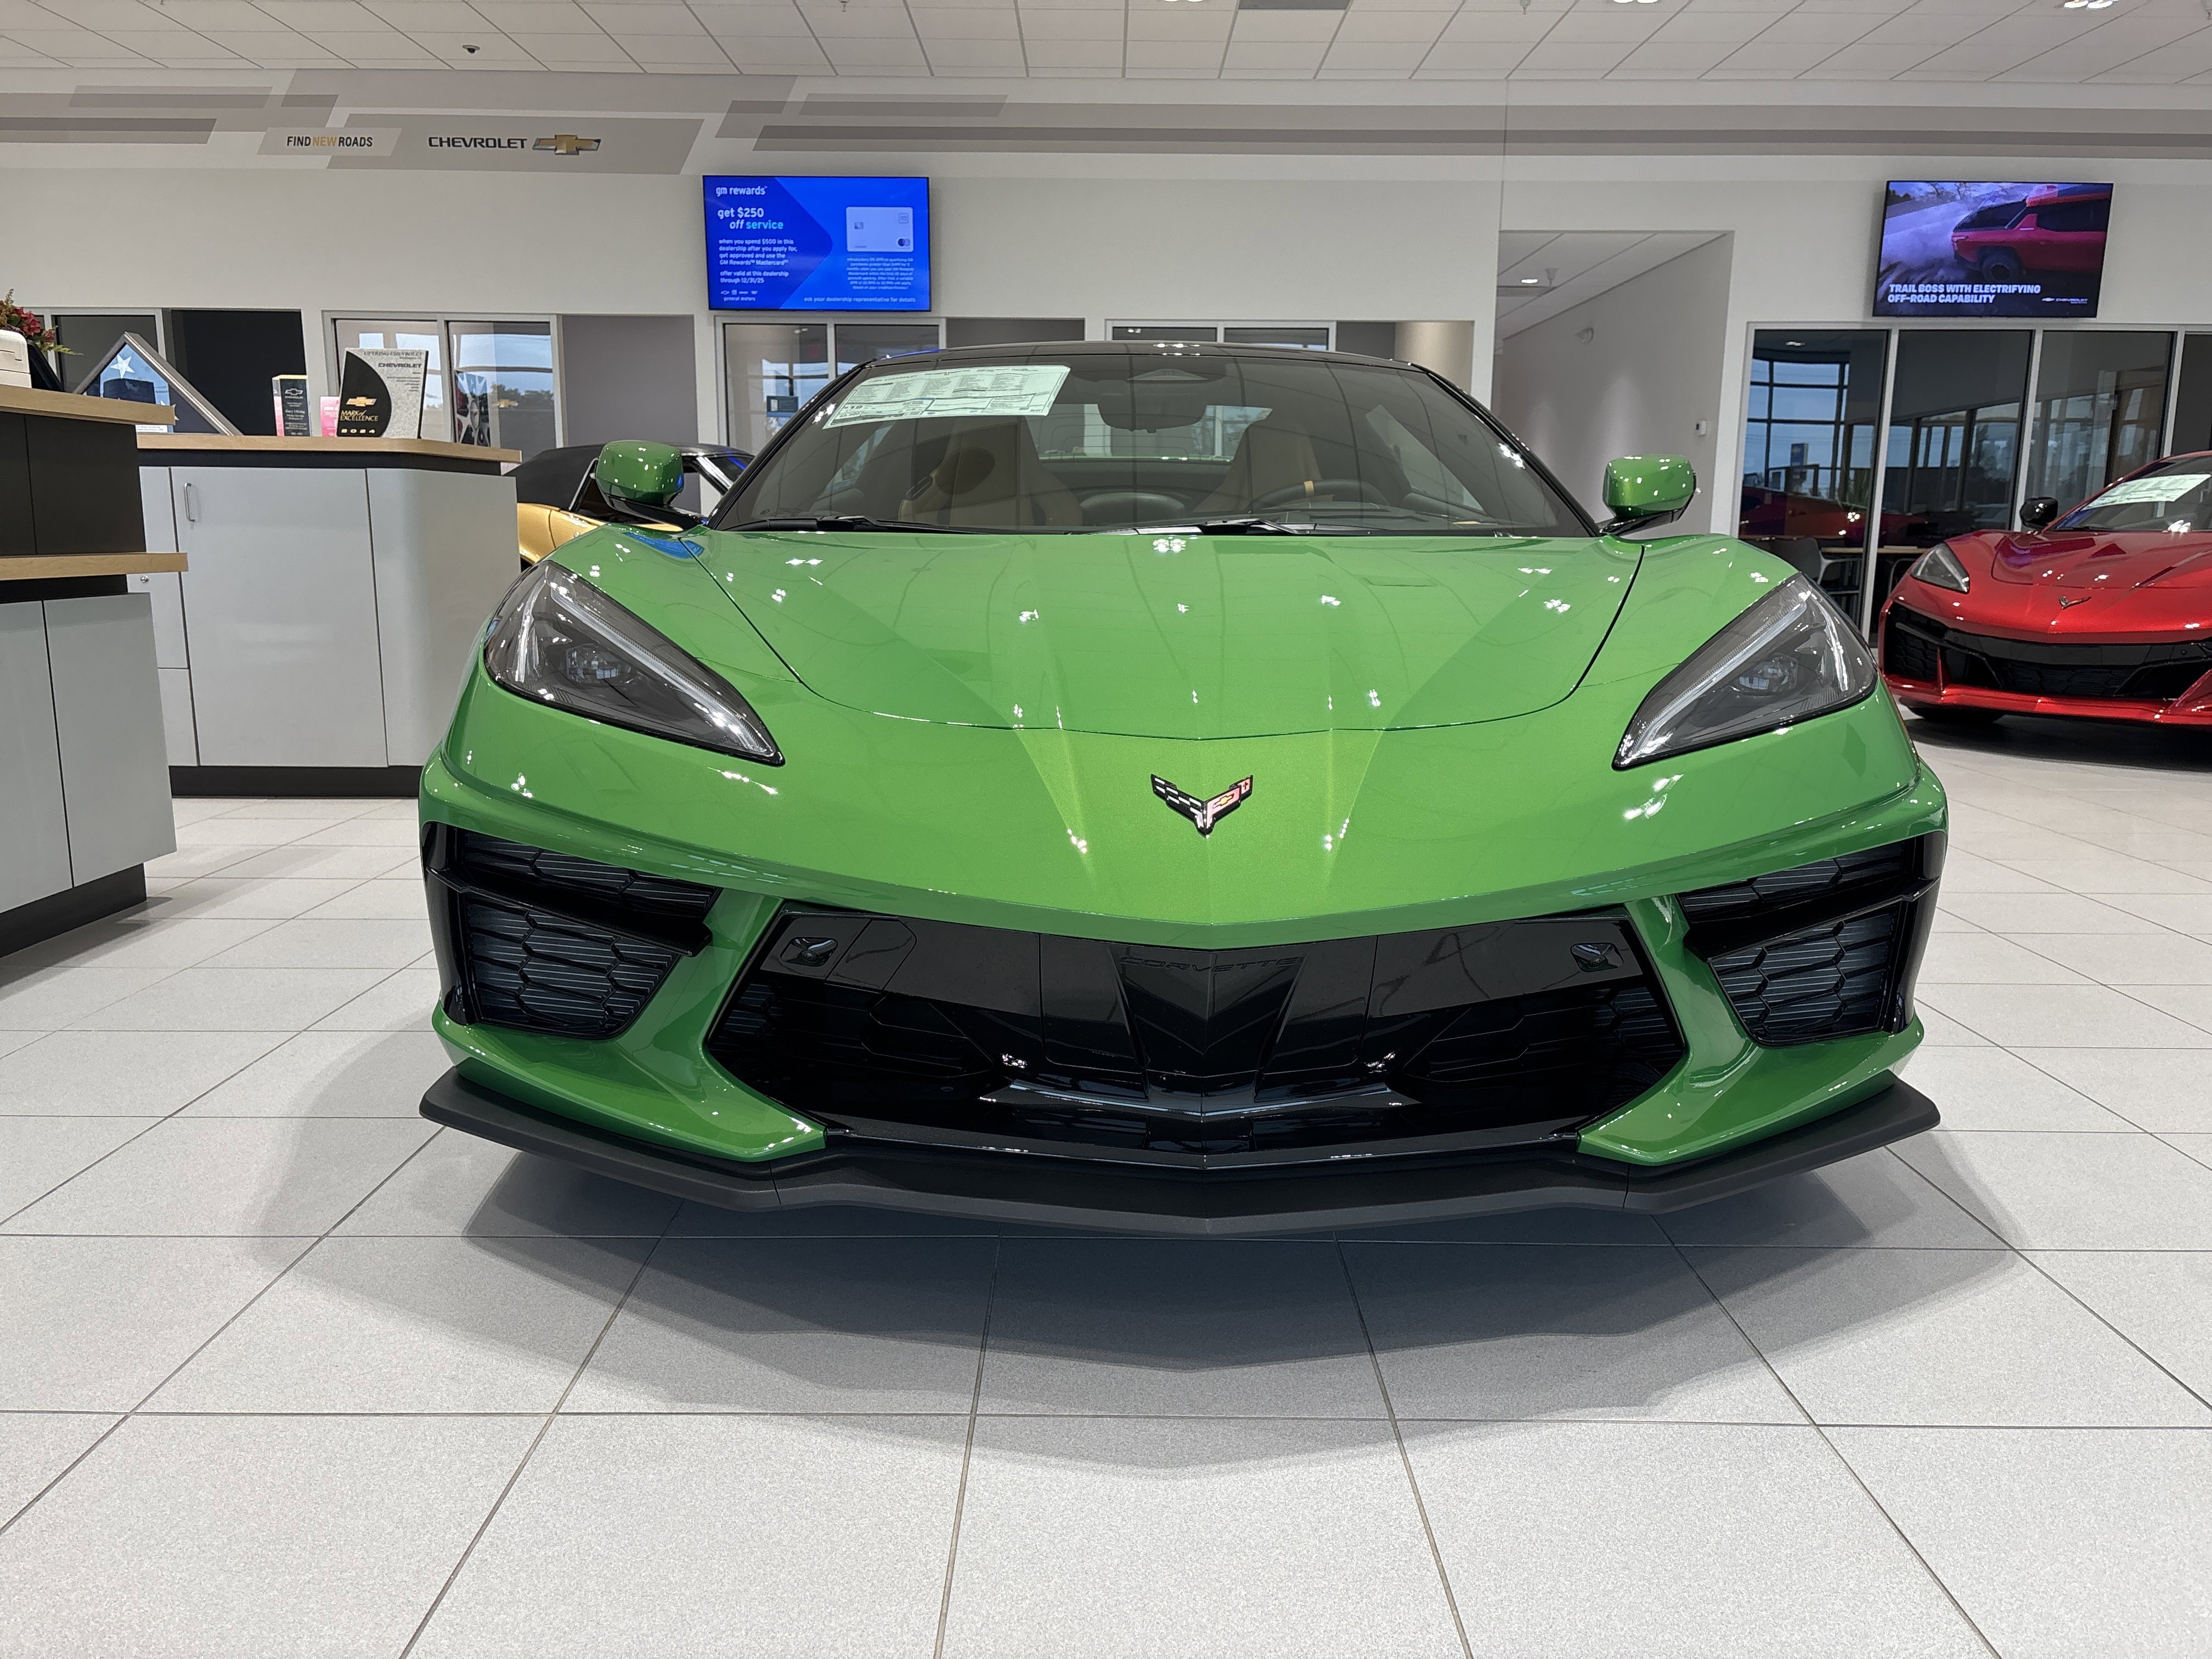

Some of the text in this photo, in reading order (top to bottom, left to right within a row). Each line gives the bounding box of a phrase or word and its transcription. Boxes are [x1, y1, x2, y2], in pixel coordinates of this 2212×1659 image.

[286, 136, 374, 148] FIND NEW ROADS
[428, 137, 528, 149] CHEVROLET
[716, 187, 727, 197] gm
[718, 207, 764, 219] get $250
[730, 219, 783, 229] off service
[1889, 284, 2041, 294] TRAIL BOSS WITH ELECTRIFYING
[1888, 294, 1996, 303] OFF-ROAD CAPABILITY
[1120, 957, 1300, 973] CORVETTE
